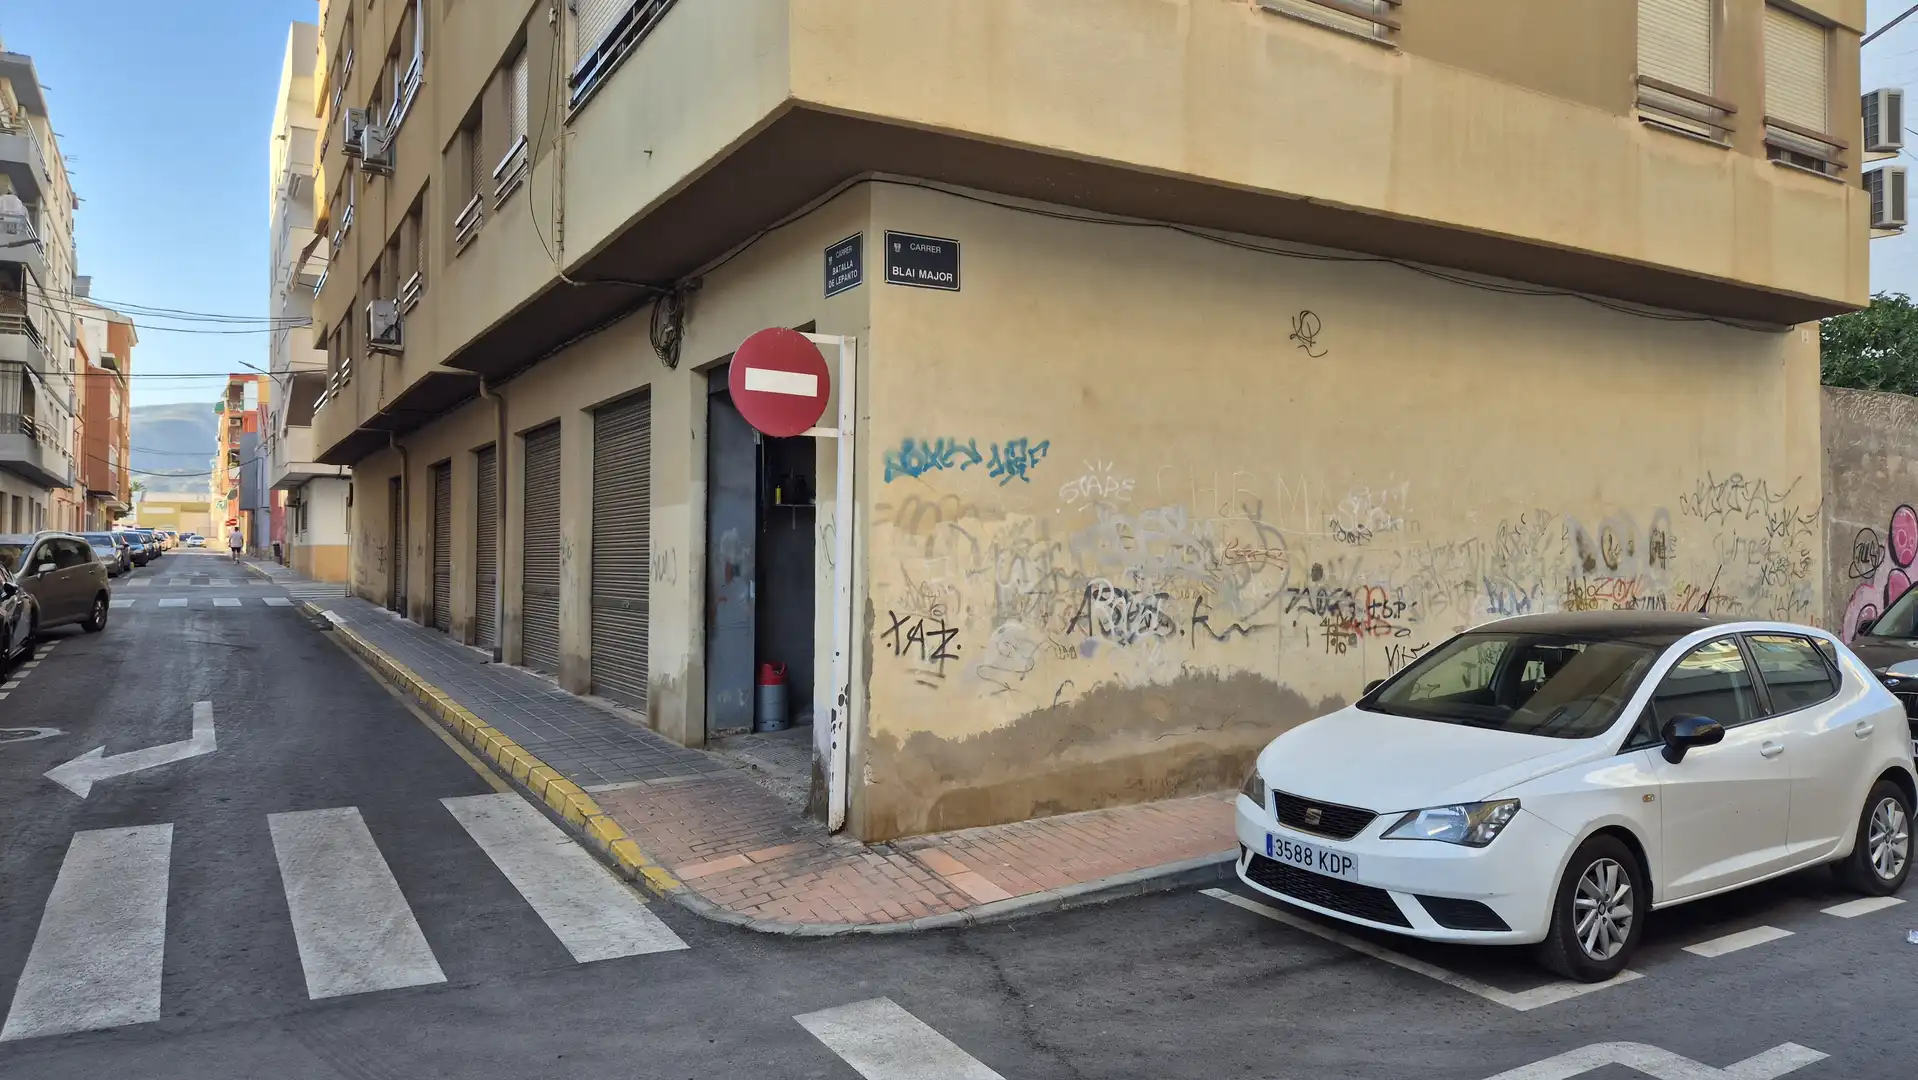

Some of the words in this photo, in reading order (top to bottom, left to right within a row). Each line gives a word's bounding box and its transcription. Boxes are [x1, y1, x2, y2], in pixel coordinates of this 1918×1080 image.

[835, 245, 853, 258] CARRER
[909, 242, 941, 254] CARRER
[832, 259, 854, 275] BATALLA
[892, 266, 915, 278] BLAI
[918, 269, 953, 282] MAJOR
[828, 278, 835, 289] DE
[835, 269, 858, 286] LEPANTO
[1275, 839, 1313, 866] 3588
[1319, 850, 1353, 875] KDP
